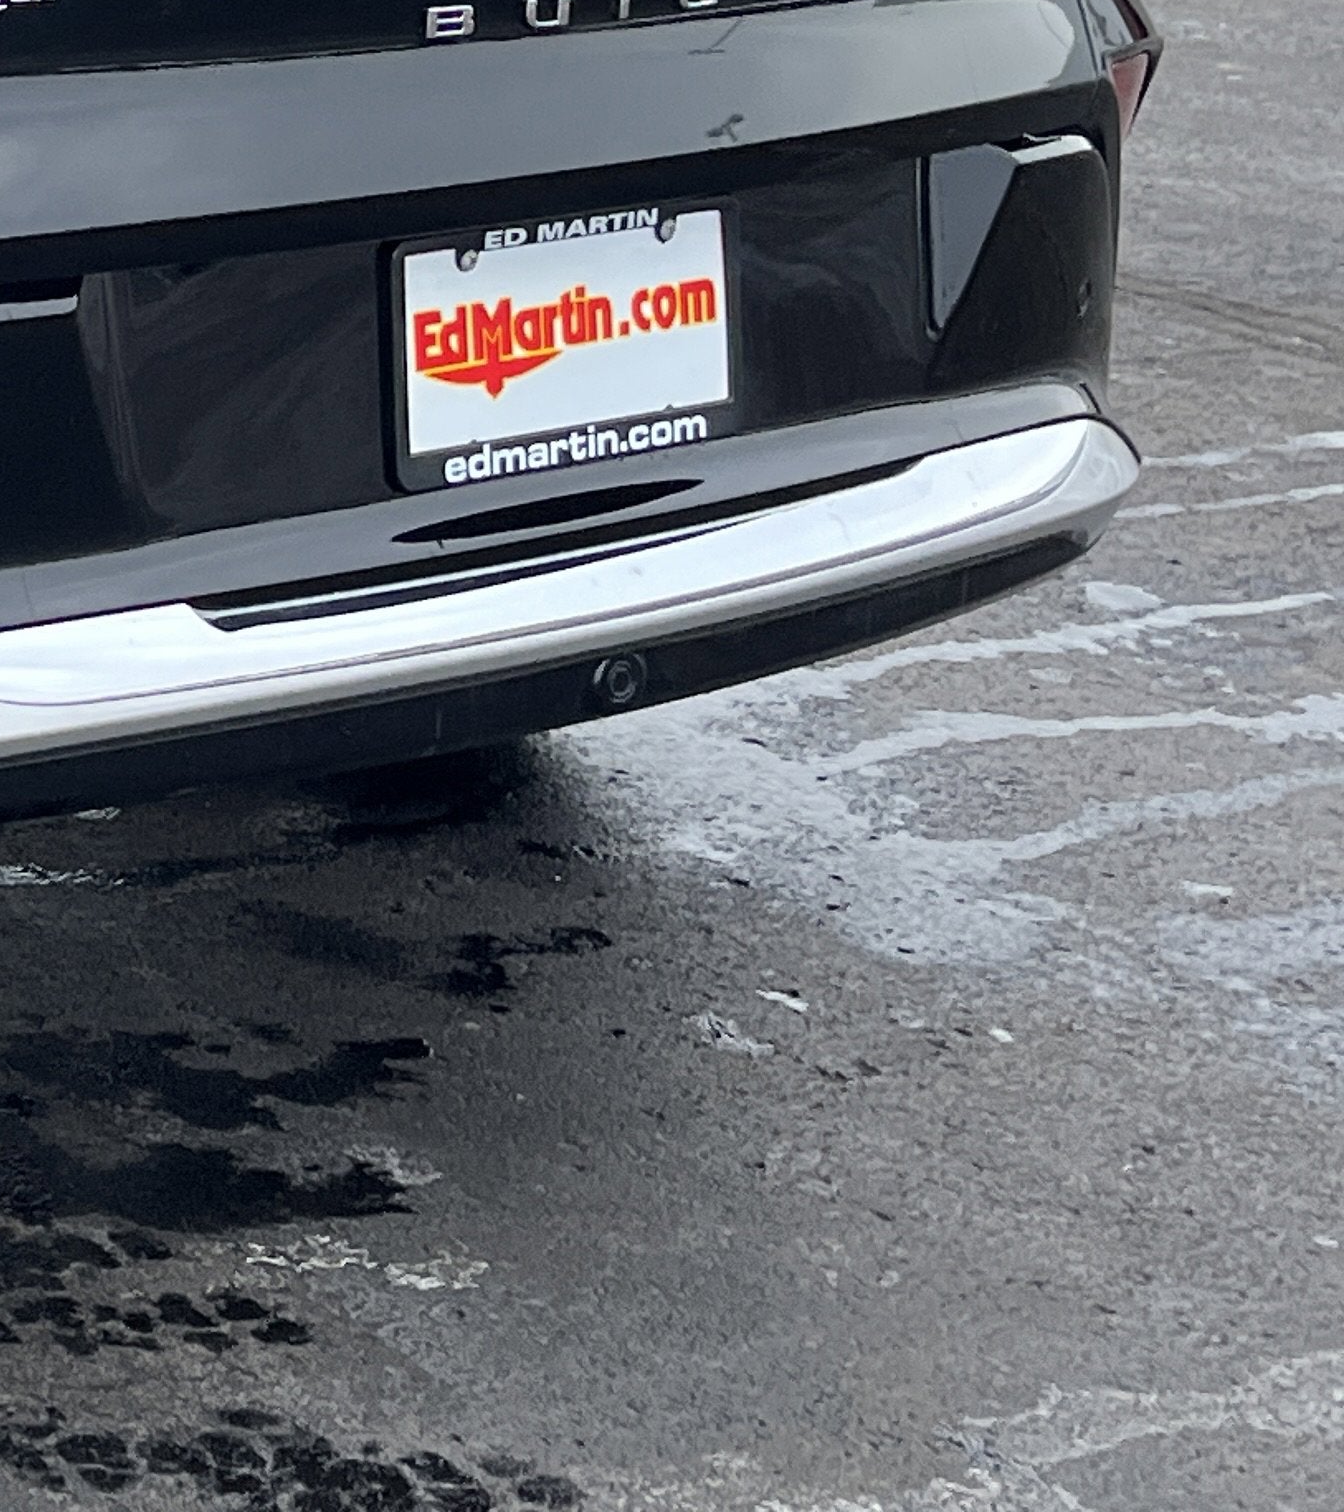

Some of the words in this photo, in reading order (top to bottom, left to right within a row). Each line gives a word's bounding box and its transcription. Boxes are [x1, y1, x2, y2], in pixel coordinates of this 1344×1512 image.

[483, 227, 528, 250] ED
[536, 207, 659, 244] MARTIN
[413, 278, 718, 372] EdMartin.com
[444, 413, 708, 484] edmartin.com
